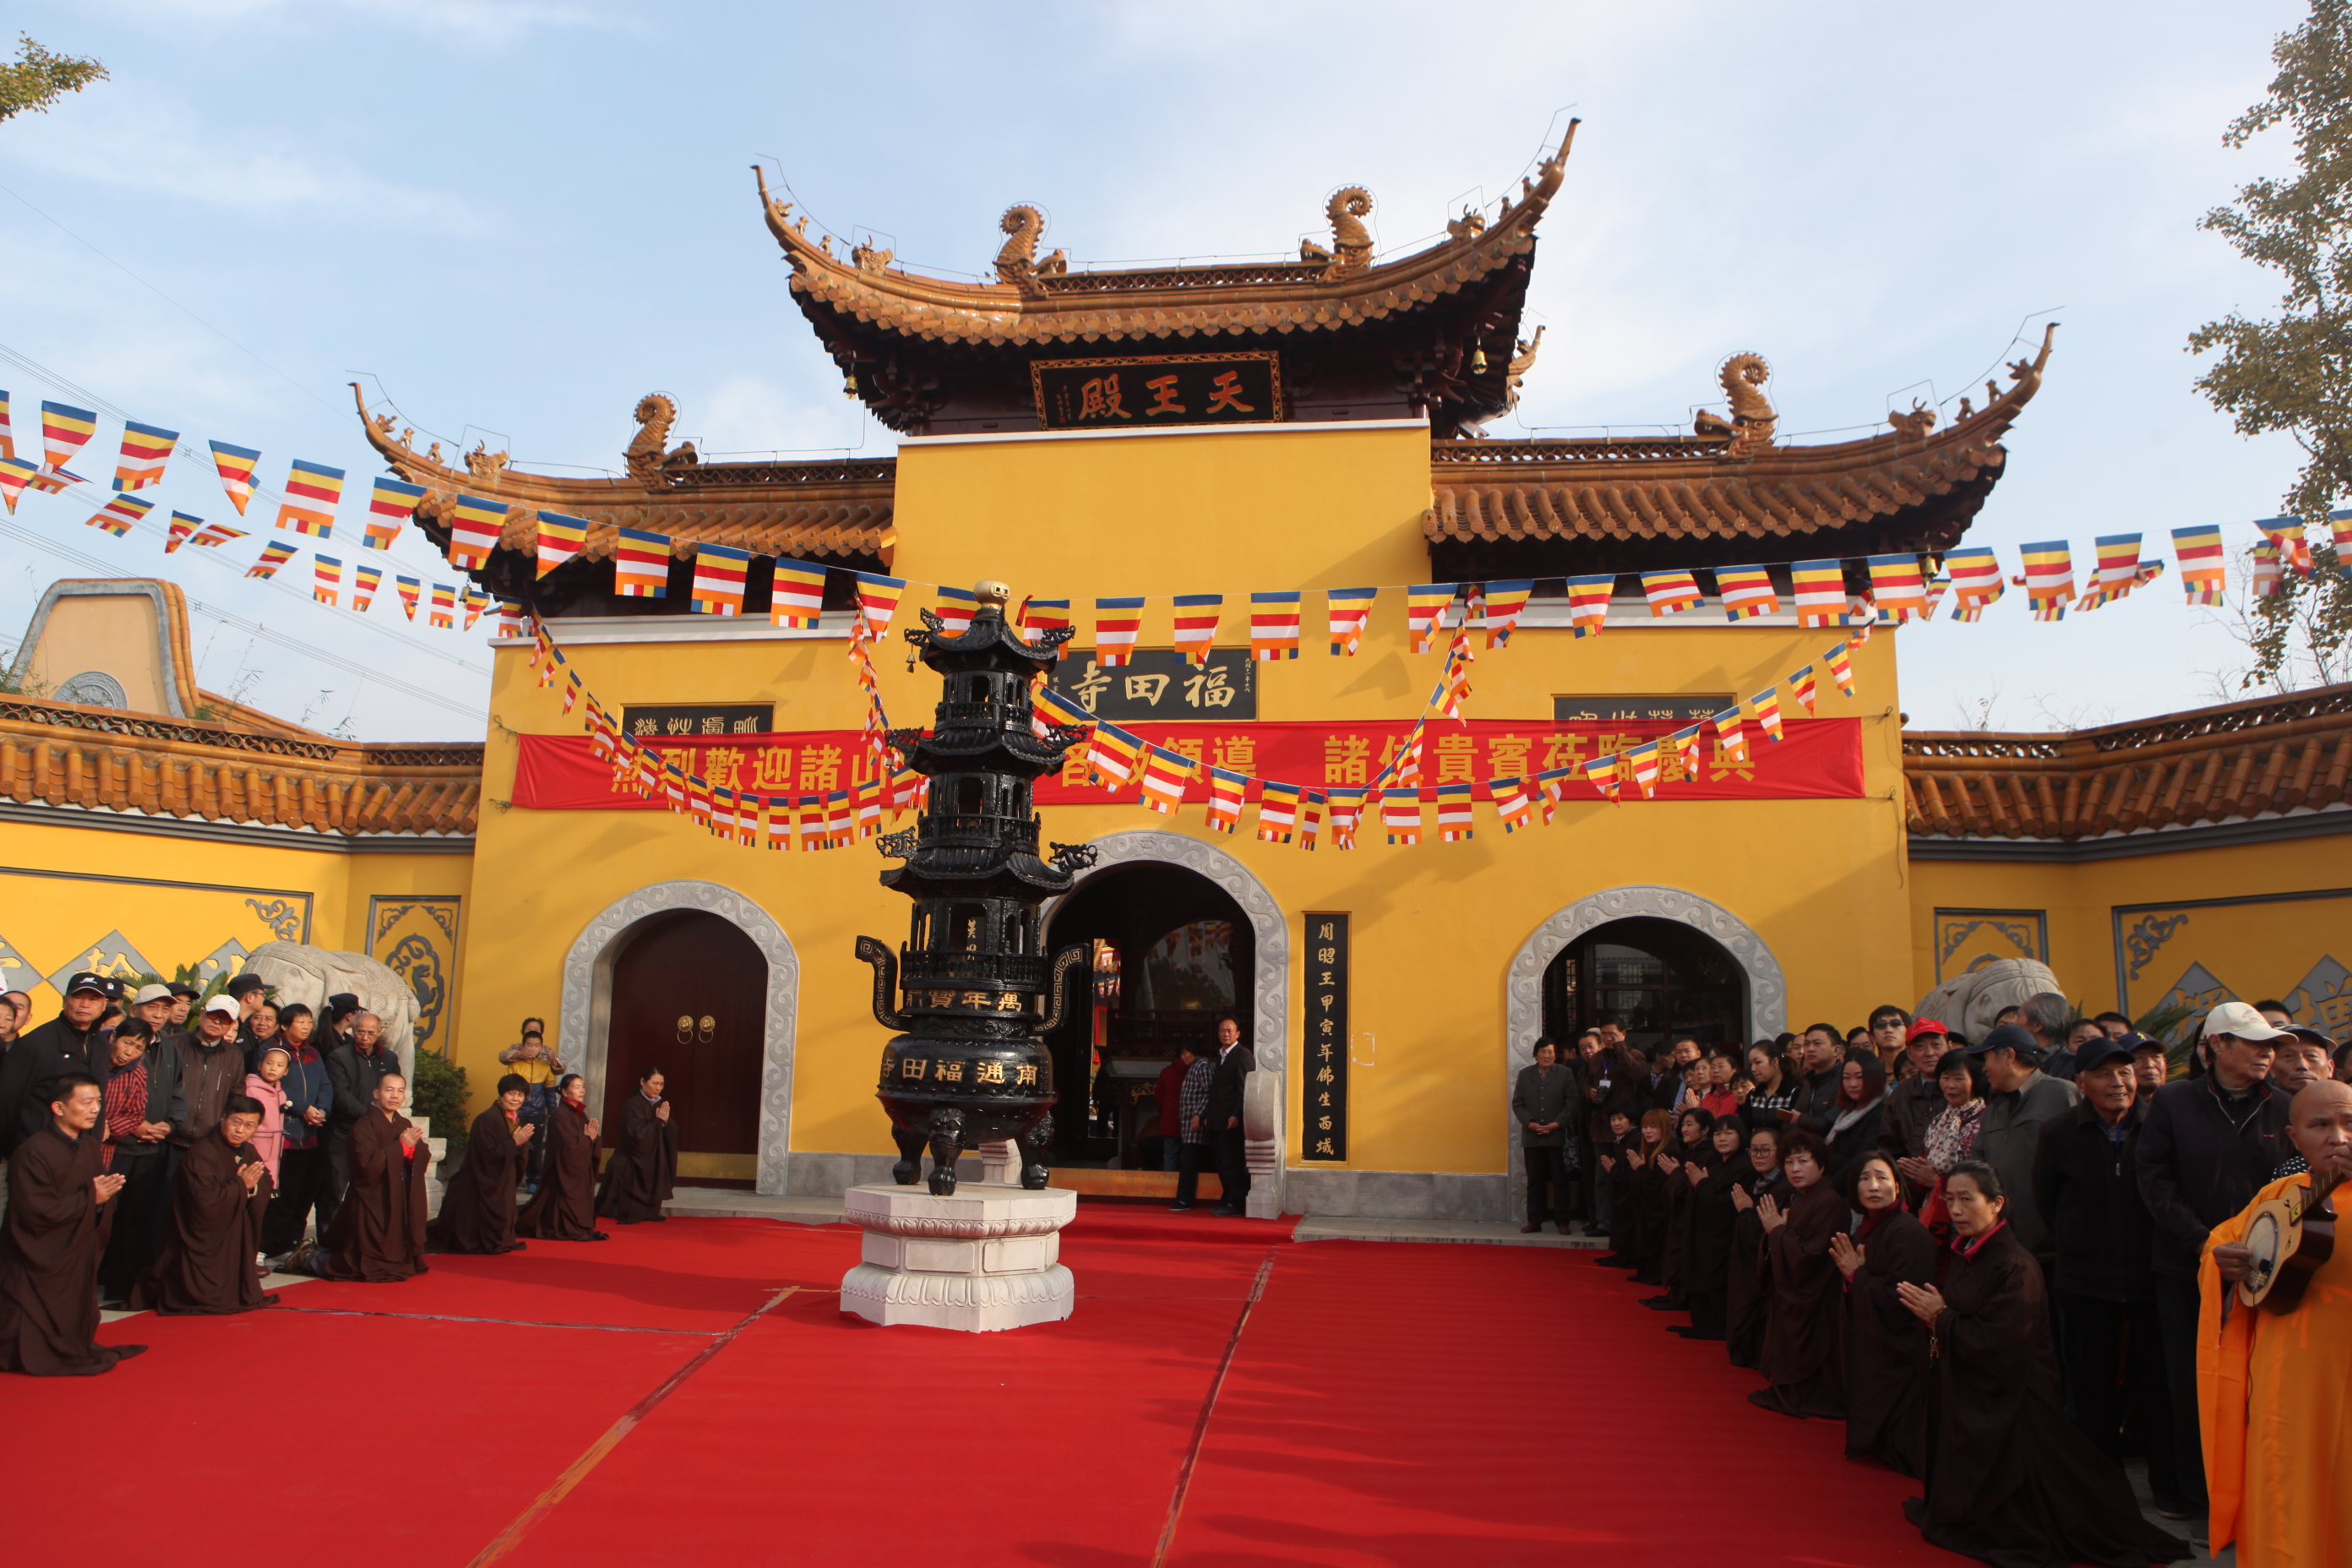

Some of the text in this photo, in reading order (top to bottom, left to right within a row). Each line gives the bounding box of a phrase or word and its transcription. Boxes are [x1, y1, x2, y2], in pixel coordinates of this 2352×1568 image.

[1078, 370, 1255, 420] 天王殿
[1070, 660, 1236, 712] 福田寺
[1315, 922, 1336, 1156] 周昭王甲寅年佛生西域
